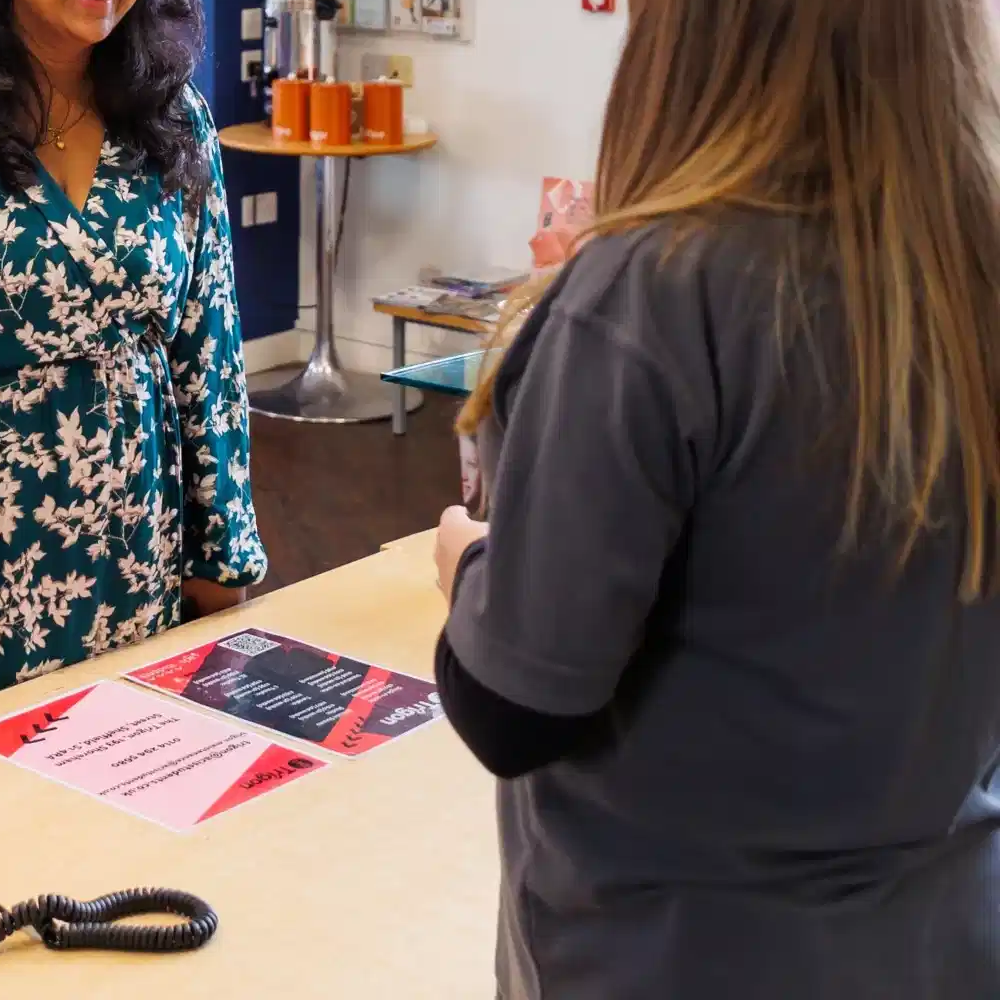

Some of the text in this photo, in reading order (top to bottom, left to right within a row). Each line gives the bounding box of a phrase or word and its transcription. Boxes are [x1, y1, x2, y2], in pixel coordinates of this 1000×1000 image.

[162, 717, 180, 726] The
[380, 701, 439, 725] Trigon
[239, 766, 297, 790] Trigon
